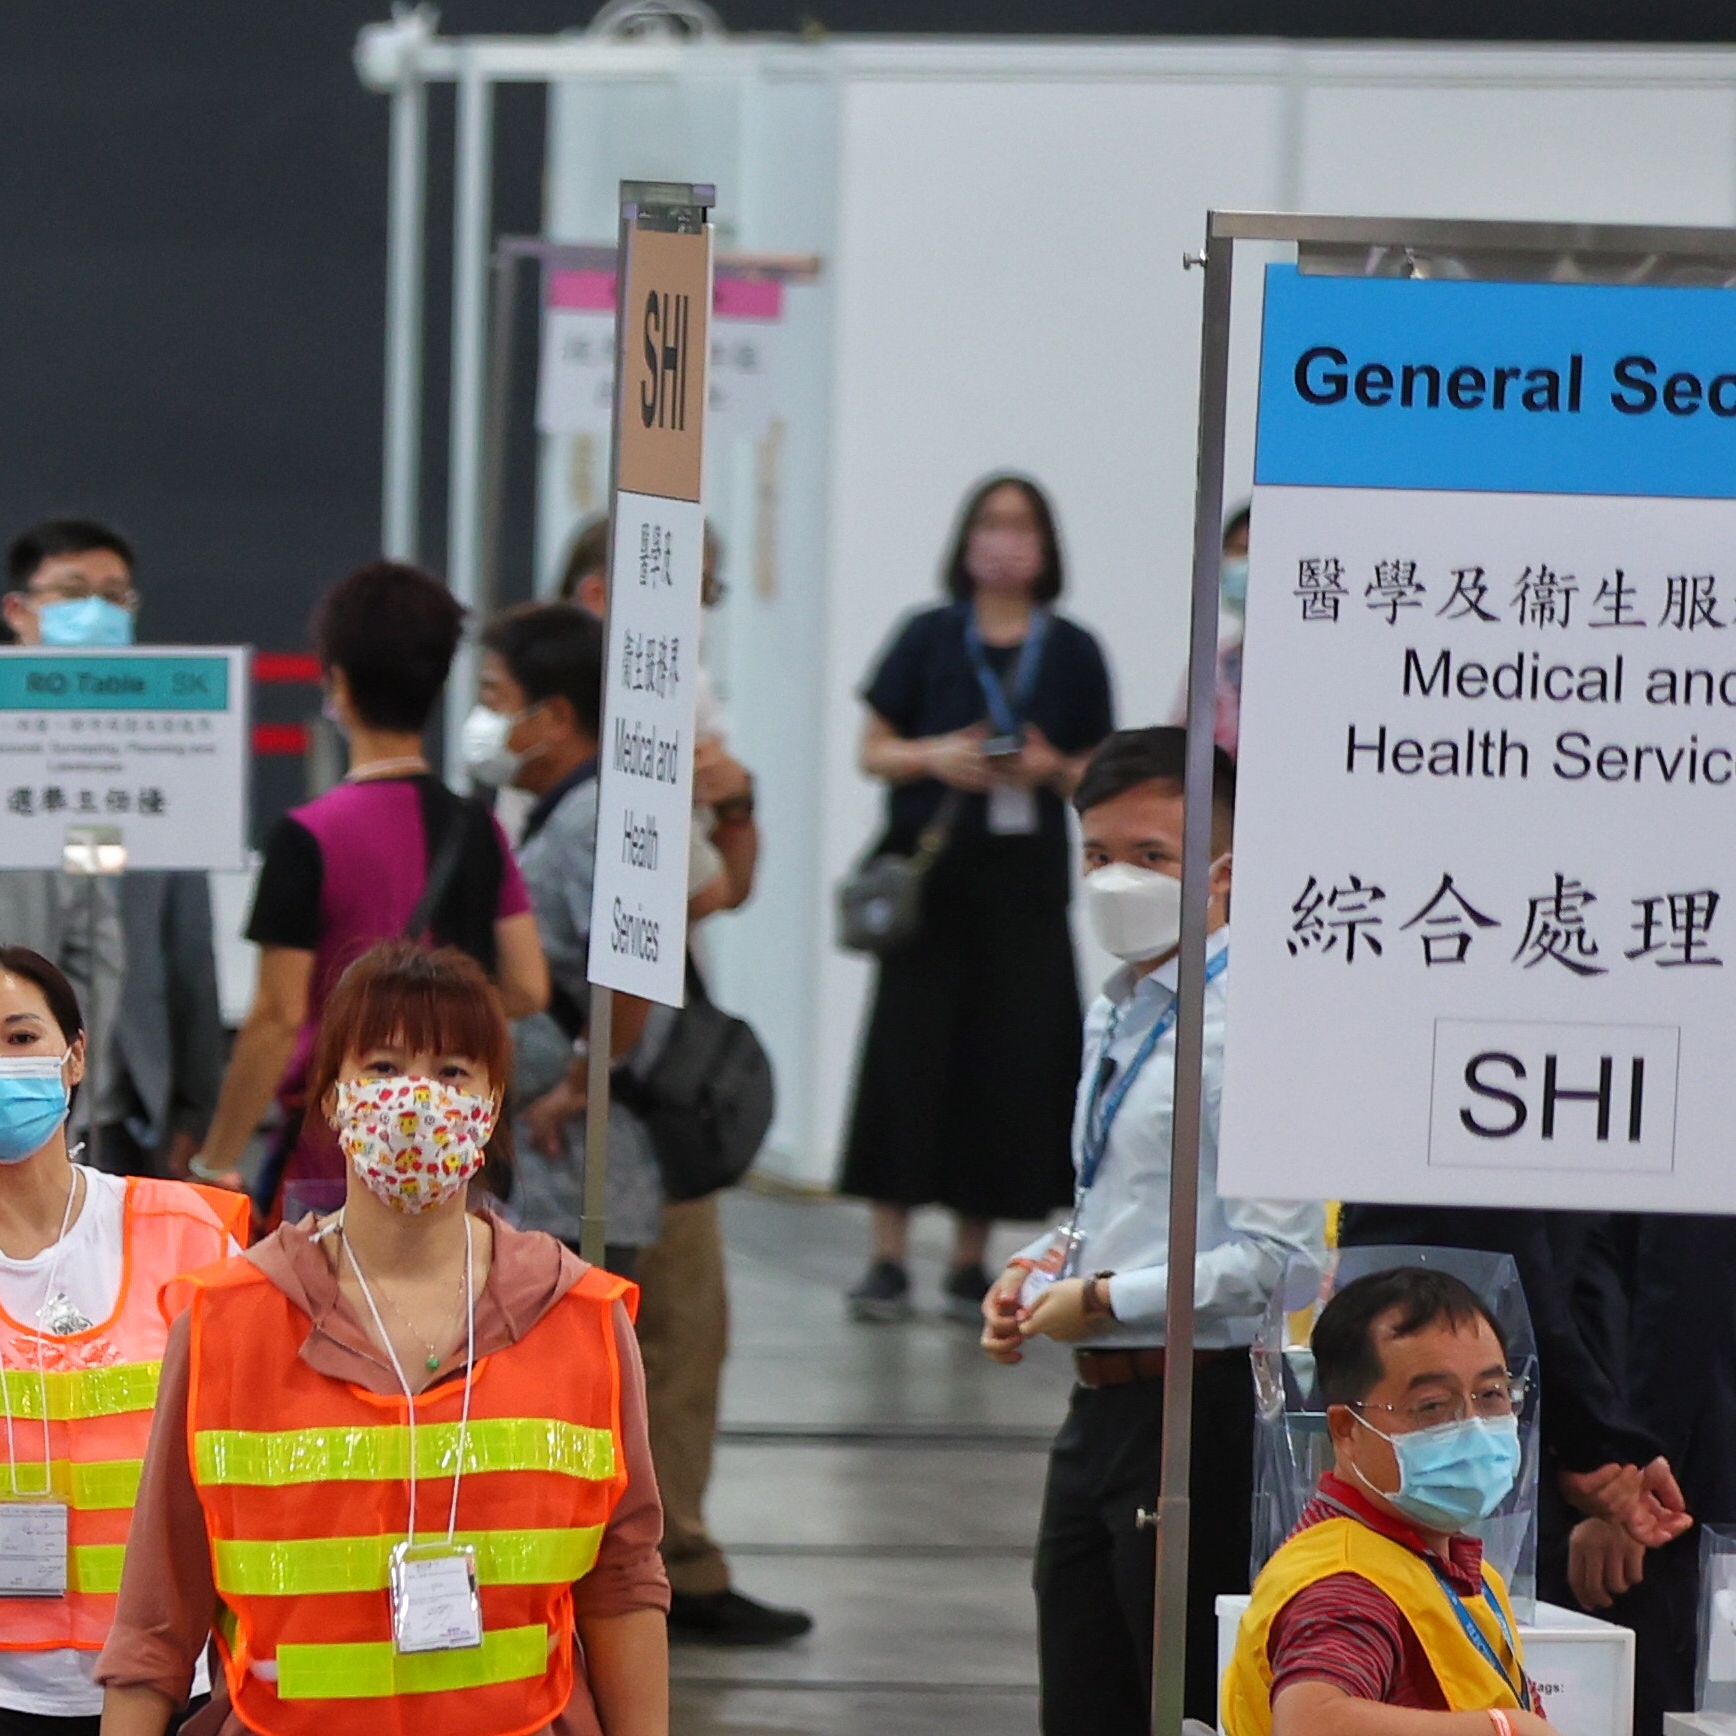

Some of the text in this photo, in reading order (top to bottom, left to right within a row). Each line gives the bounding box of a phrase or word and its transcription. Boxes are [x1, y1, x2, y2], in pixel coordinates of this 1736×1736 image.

[640, 289, 689, 432] SHI
[1293, 345, 1584, 413] General
[1292, 557, 1736, 632] 醫學及衞生服
[77, 671, 146, 697] Table
[1402, 647, 1625, 703] Medical
[613, 717, 680, 785] Medical and
[1345, 723, 1530, 779] Health
[622, 809, 659, 871] Health
[611, 895, 660, 965] Services
[1285, 871, 1725, 978] 綜合處理
[1458, 1050, 1646, 1144] SHI
[1534, 1681, 1565, 1697] ags:
